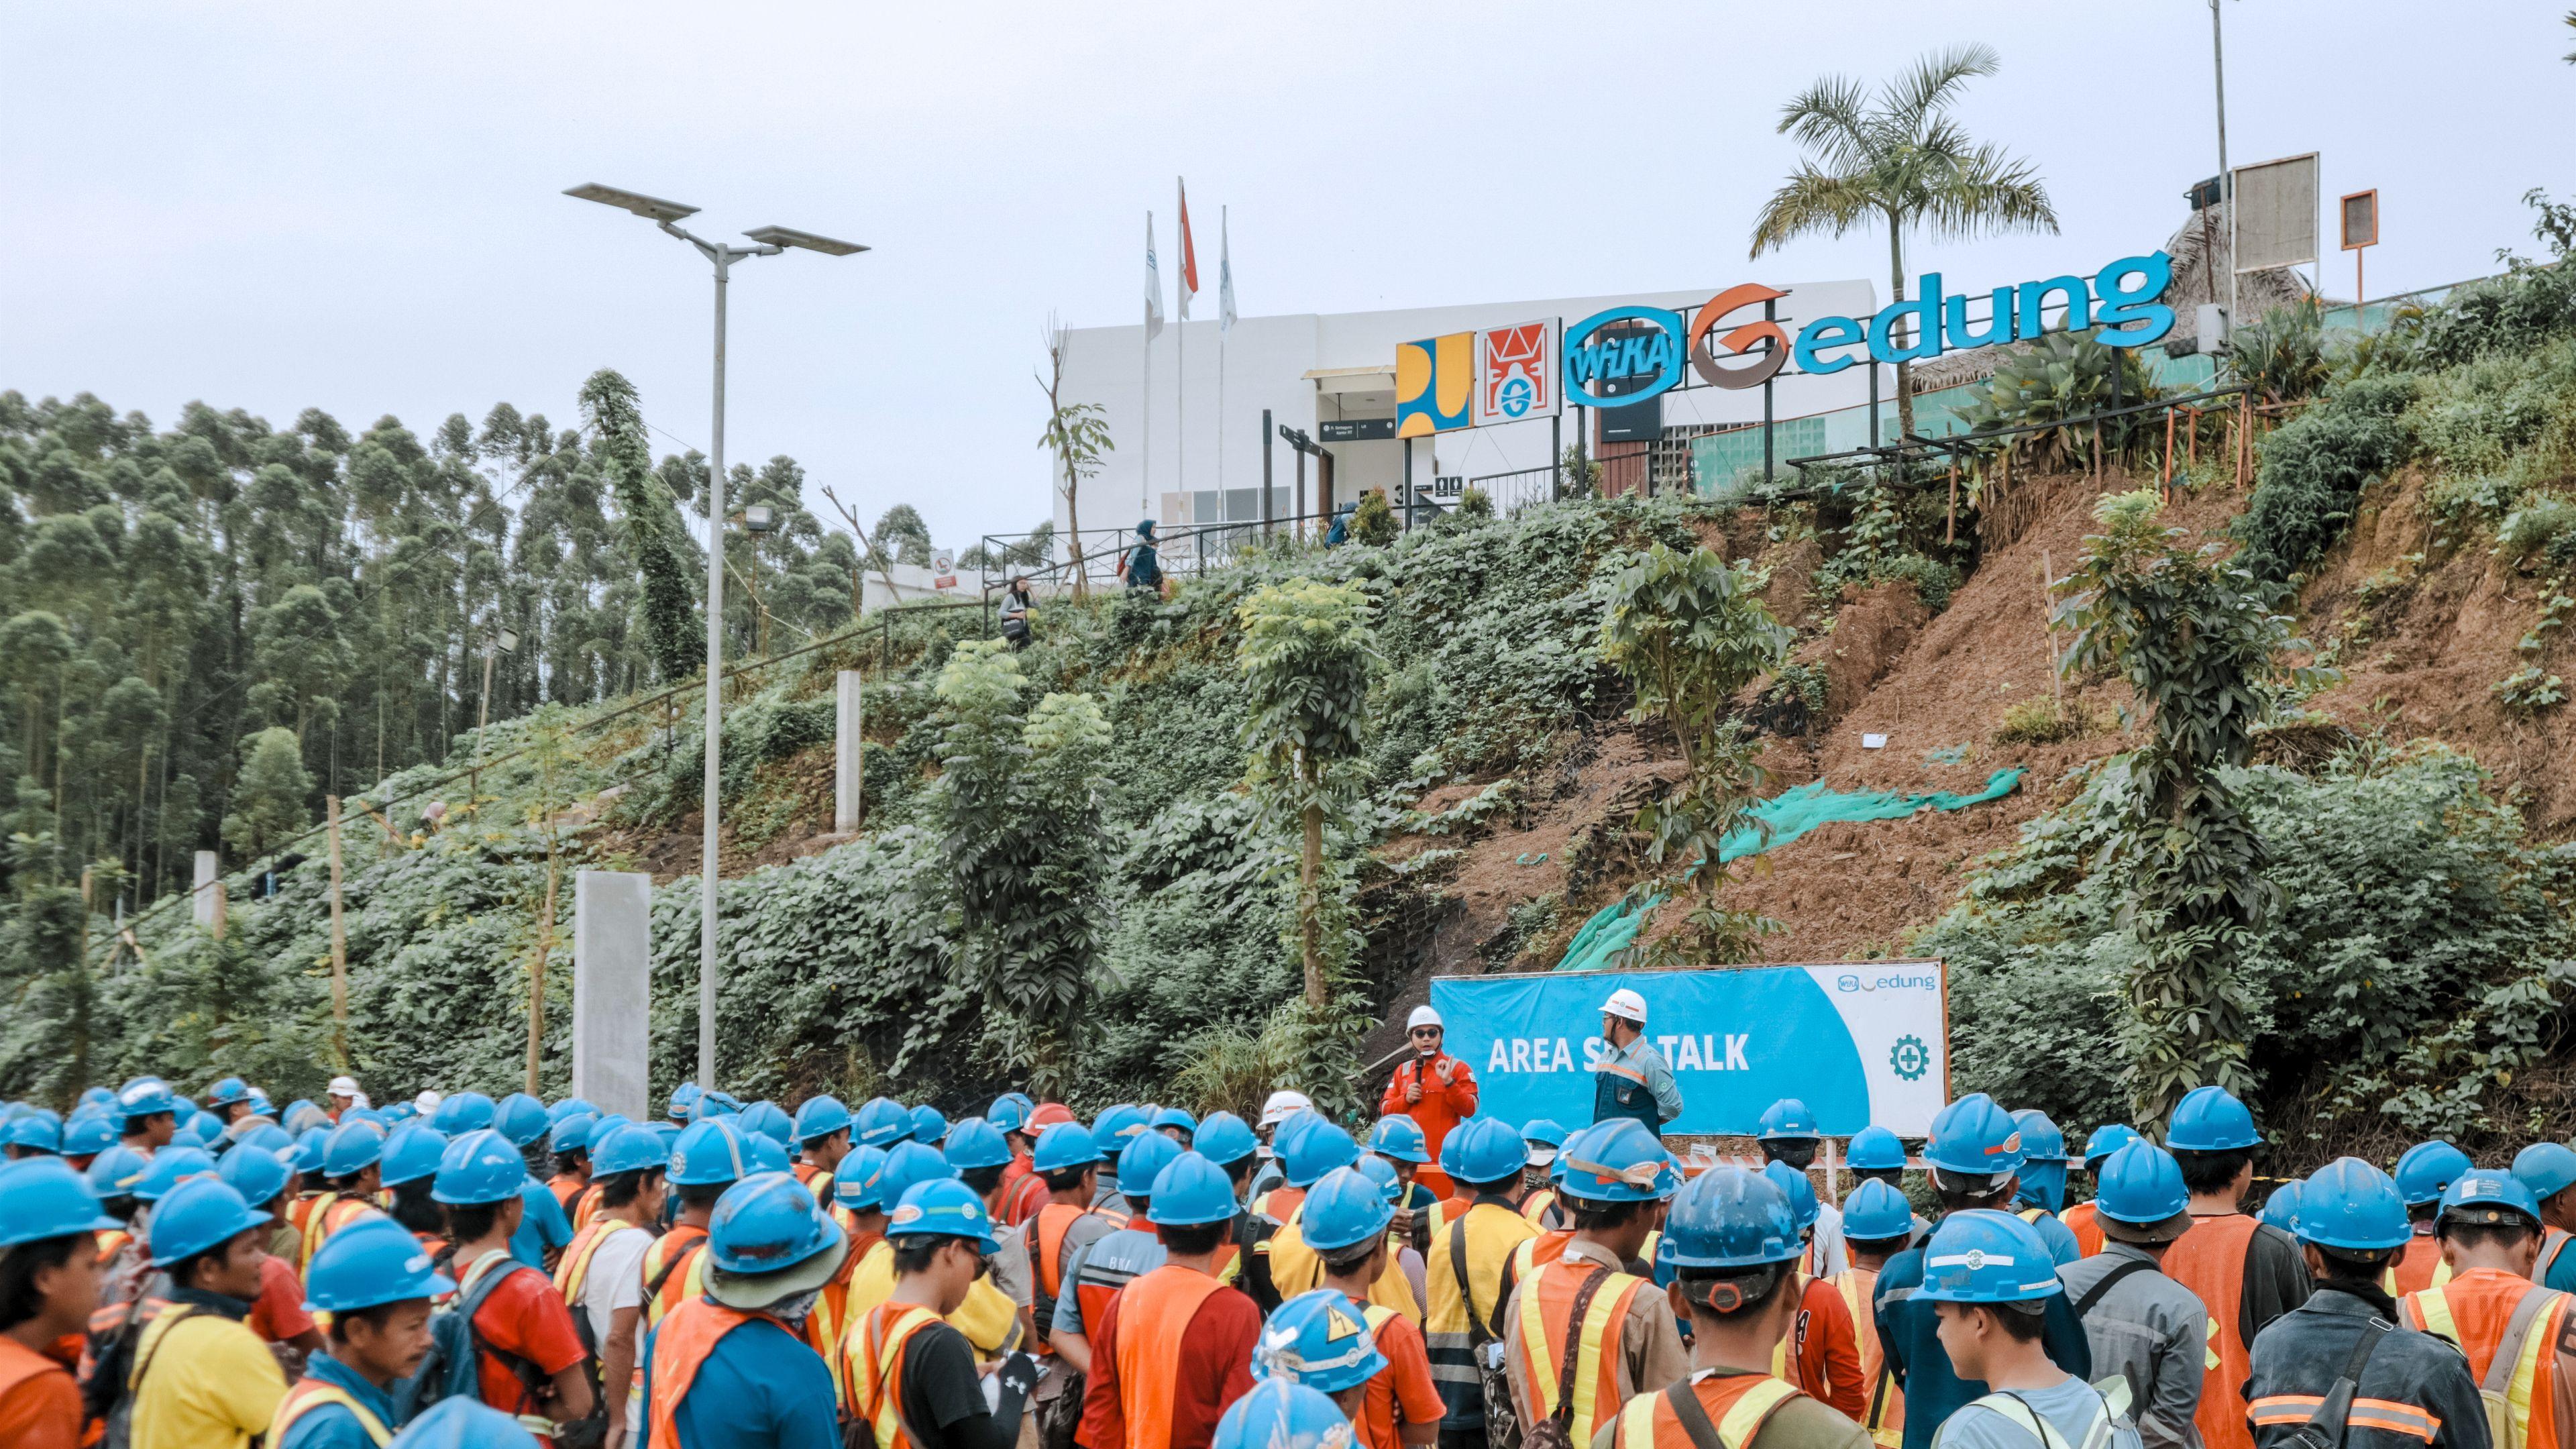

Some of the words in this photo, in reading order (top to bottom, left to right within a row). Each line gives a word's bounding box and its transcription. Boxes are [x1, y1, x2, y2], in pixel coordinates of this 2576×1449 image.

[1690, 248, 2175, 390] Gedung
[1487, 1038, 1574, 1073] AREA
[1657, 1034, 1750, 1071] TALK
